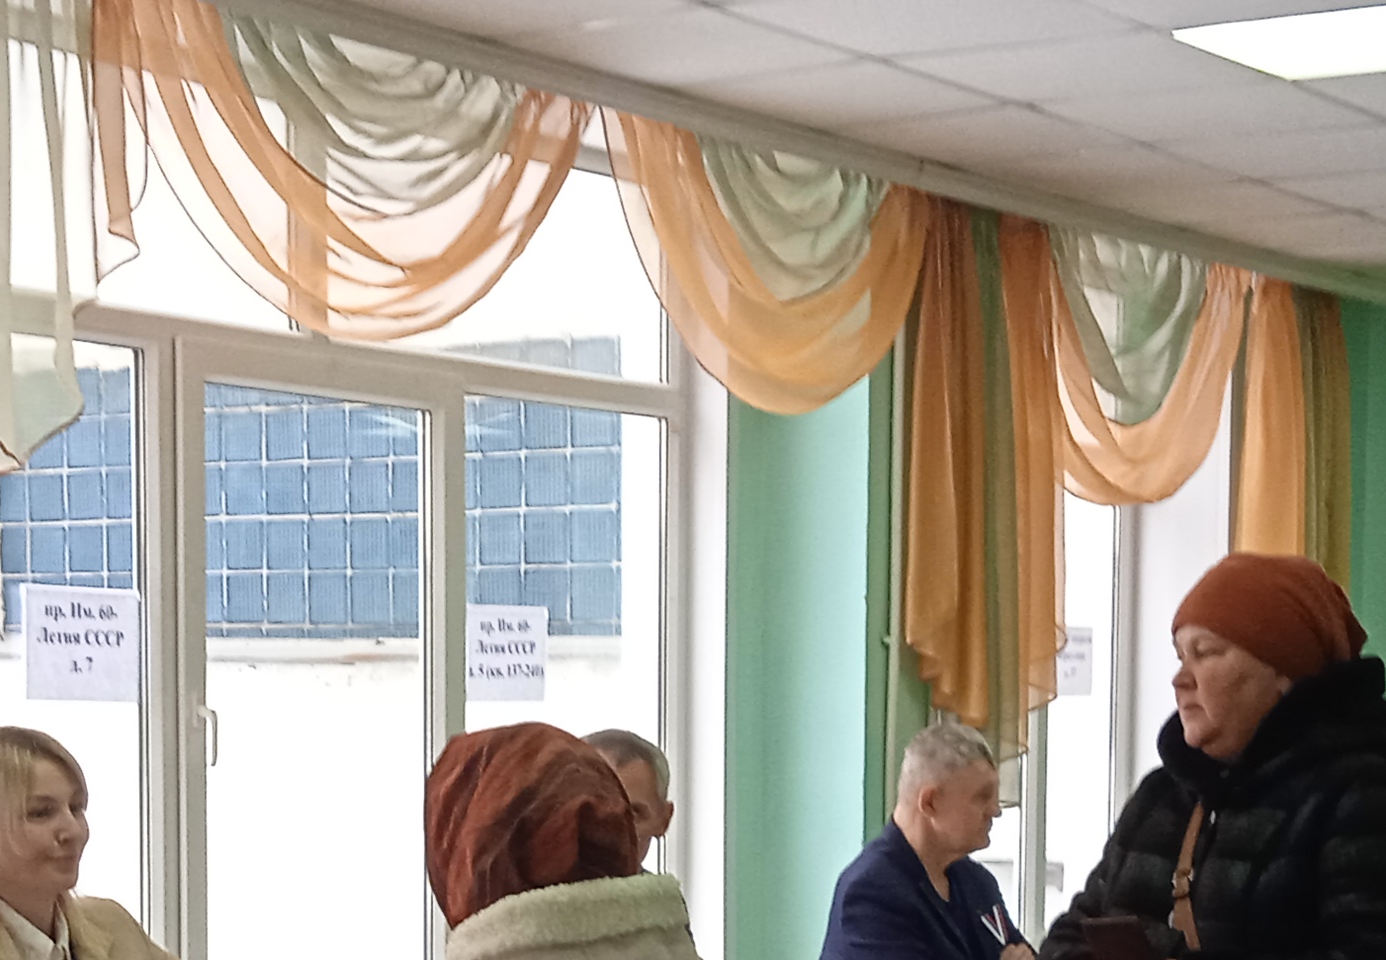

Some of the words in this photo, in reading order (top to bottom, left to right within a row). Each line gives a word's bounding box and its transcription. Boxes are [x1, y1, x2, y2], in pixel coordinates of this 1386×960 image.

[44, 604, 66, 621] пр.
[70, 601, 95, 619] Им.
[36, 626, 81, 644] Летия
[84, 629, 125, 646] СССР
[507, 641, 537, 655] СССР
[85, 655, 94, 673] 7
